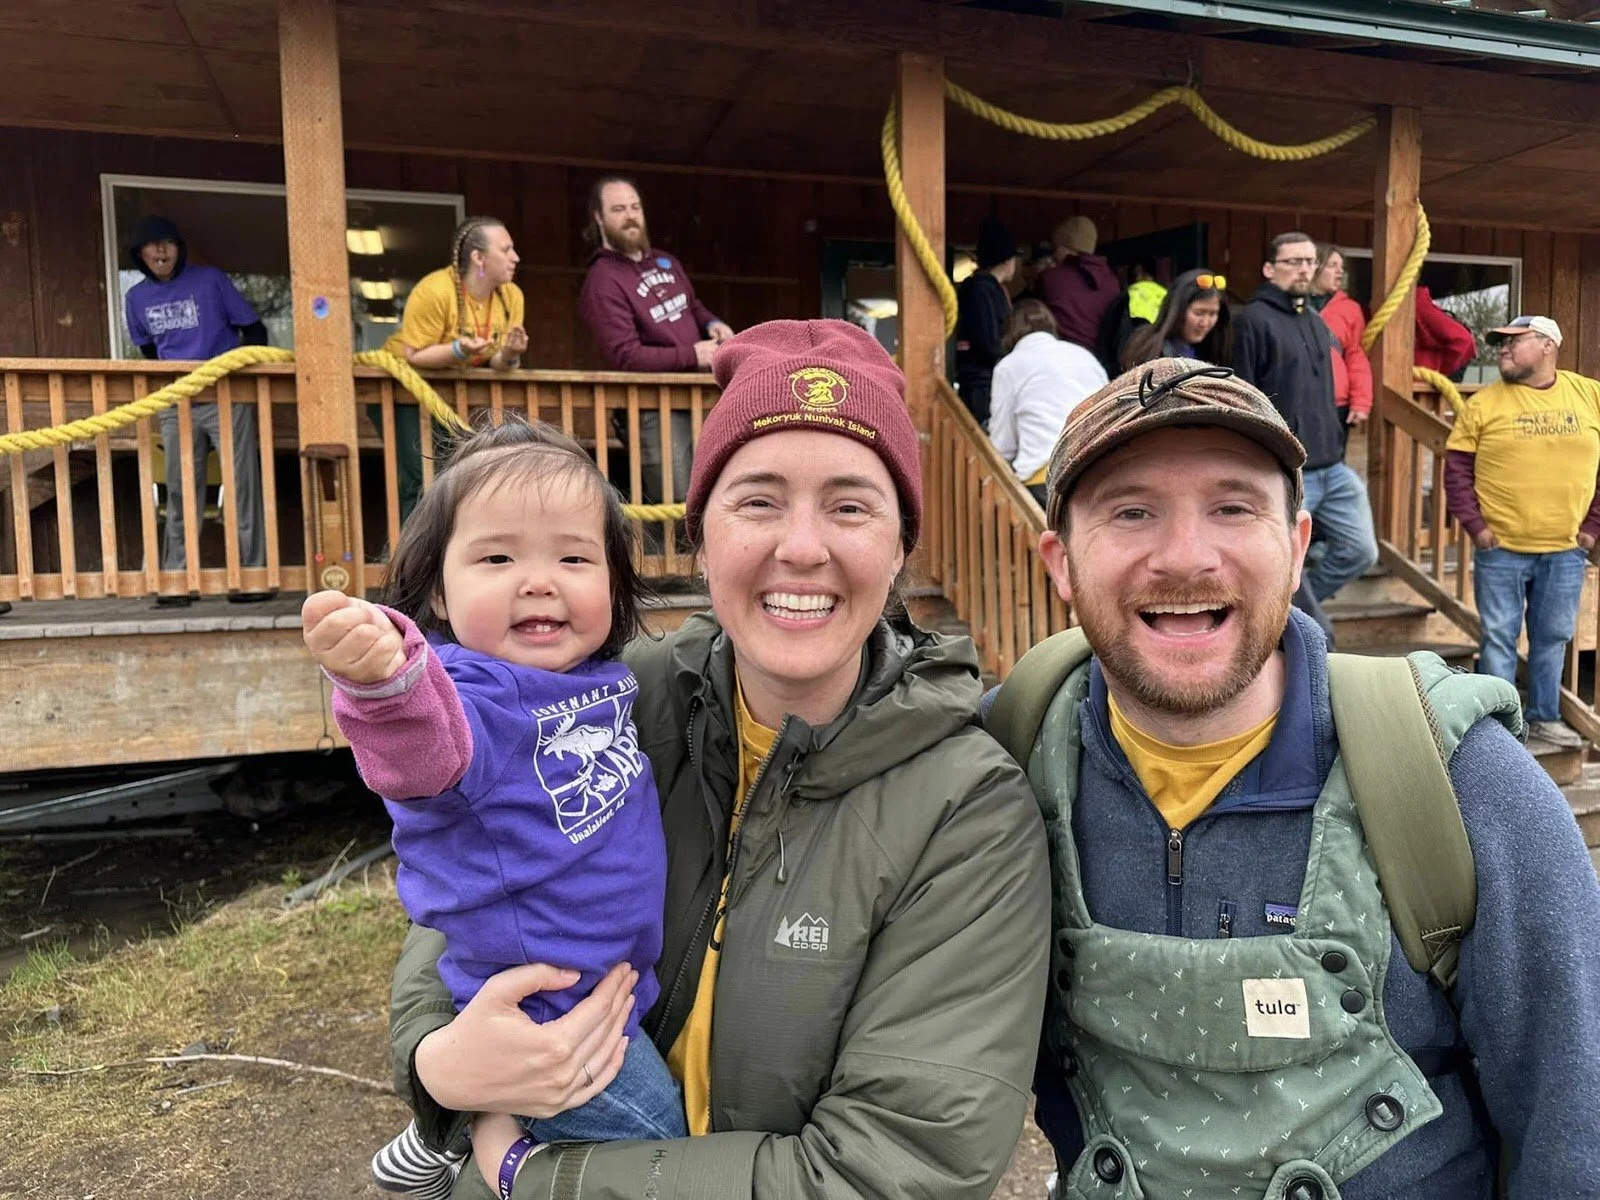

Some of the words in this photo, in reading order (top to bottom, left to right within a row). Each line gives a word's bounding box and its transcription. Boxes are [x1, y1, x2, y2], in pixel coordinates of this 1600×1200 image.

[753, 412, 802, 430] Mekoryuk
[804, 413, 845, 428] Nunivak
[847, 420, 876, 440] Island
[792, 925, 829, 944] REI
[1255, 999, 1297, 1016] tula
